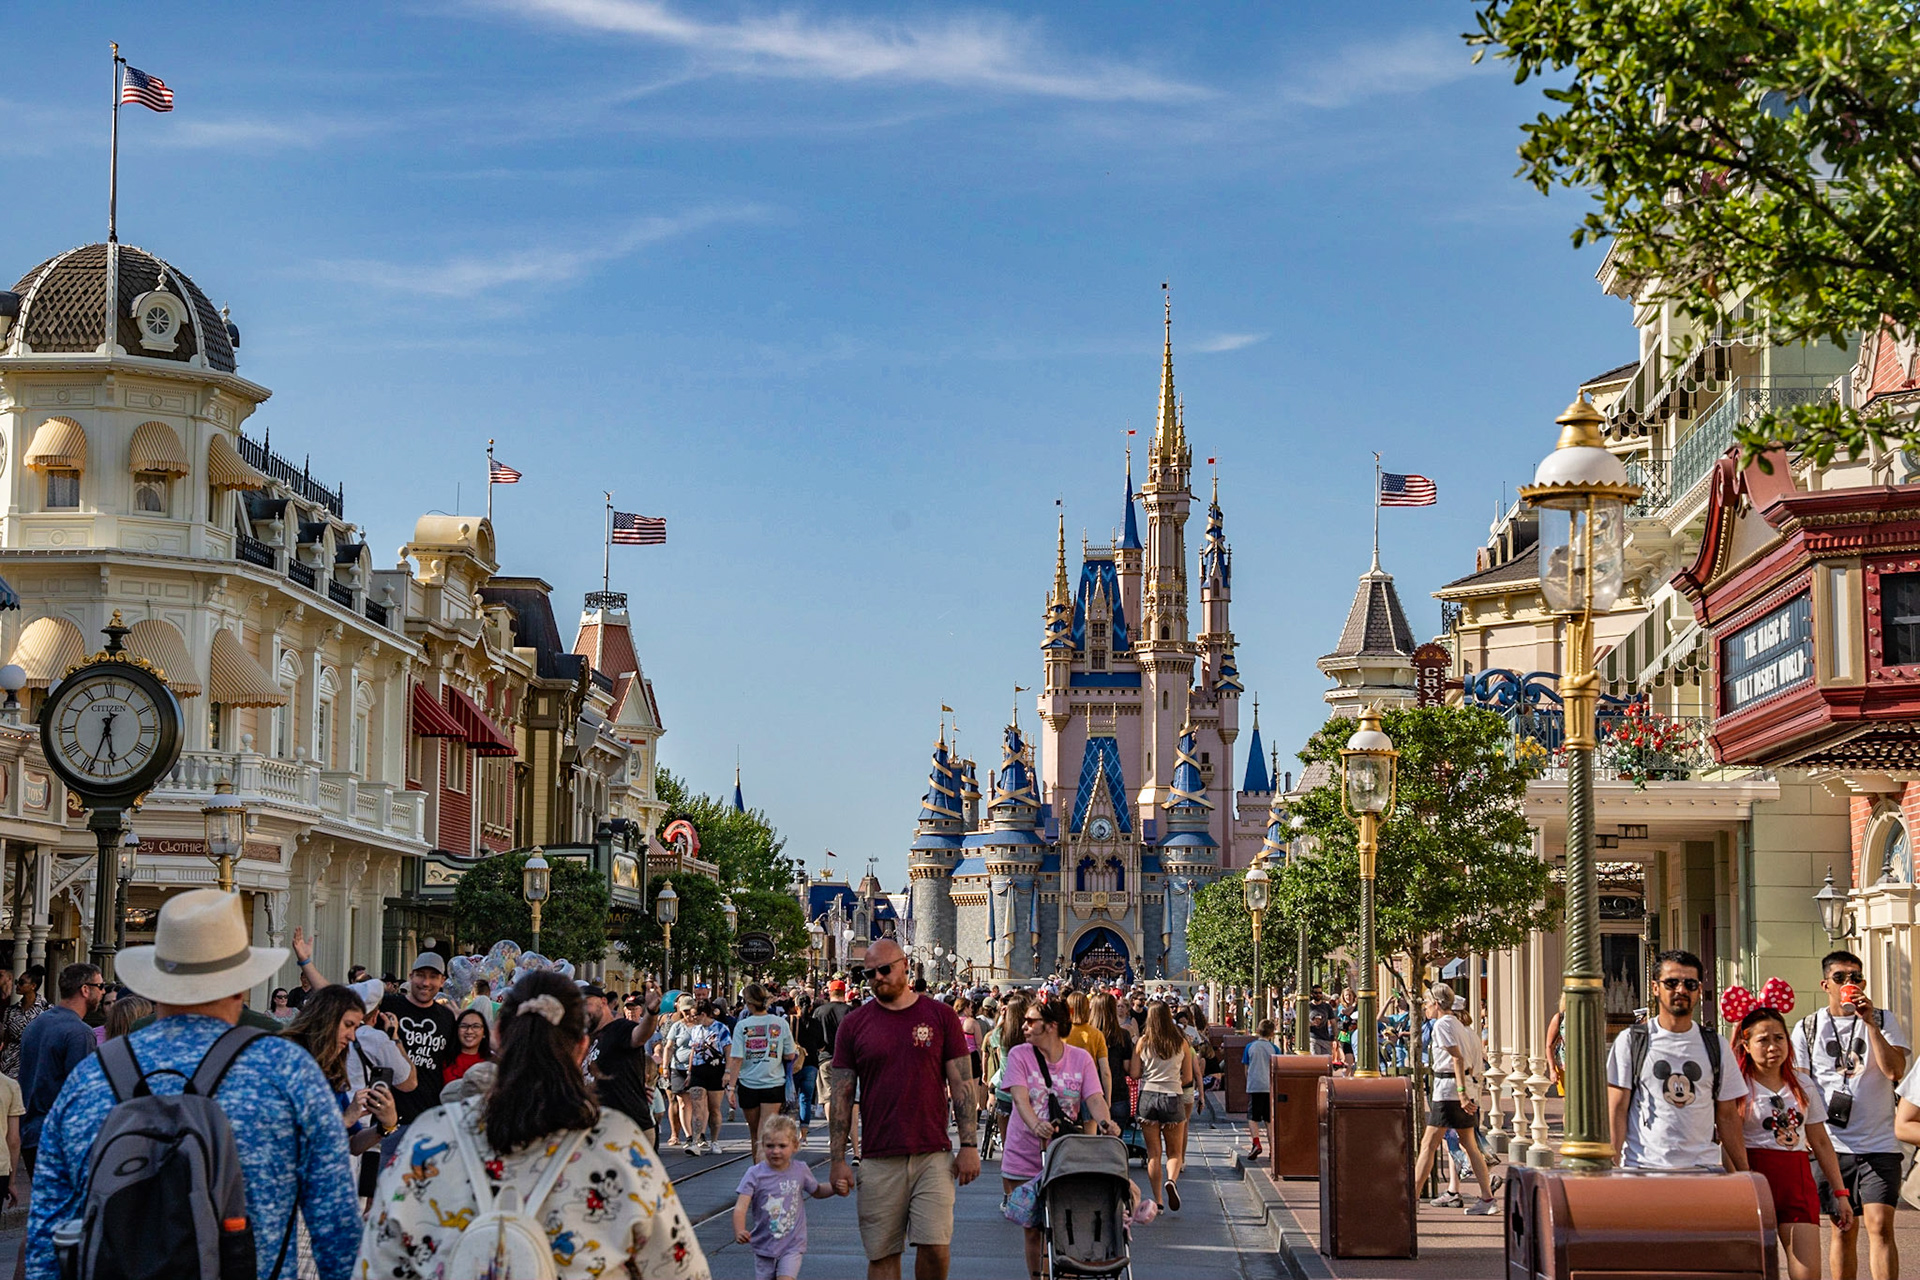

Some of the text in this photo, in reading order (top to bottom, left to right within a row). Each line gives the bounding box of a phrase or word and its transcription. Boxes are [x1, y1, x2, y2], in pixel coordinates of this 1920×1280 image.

[1744, 611, 1790, 660] THE MAGIC OF
[1735, 649, 1805, 705] WALT DISNEY WORLD
[91, 704, 127, 712] CITIZEN
[26, 786, 43, 802] TOYS
[405, 1030, 447, 1052] gang's
[415, 1046, 431, 1057] all
